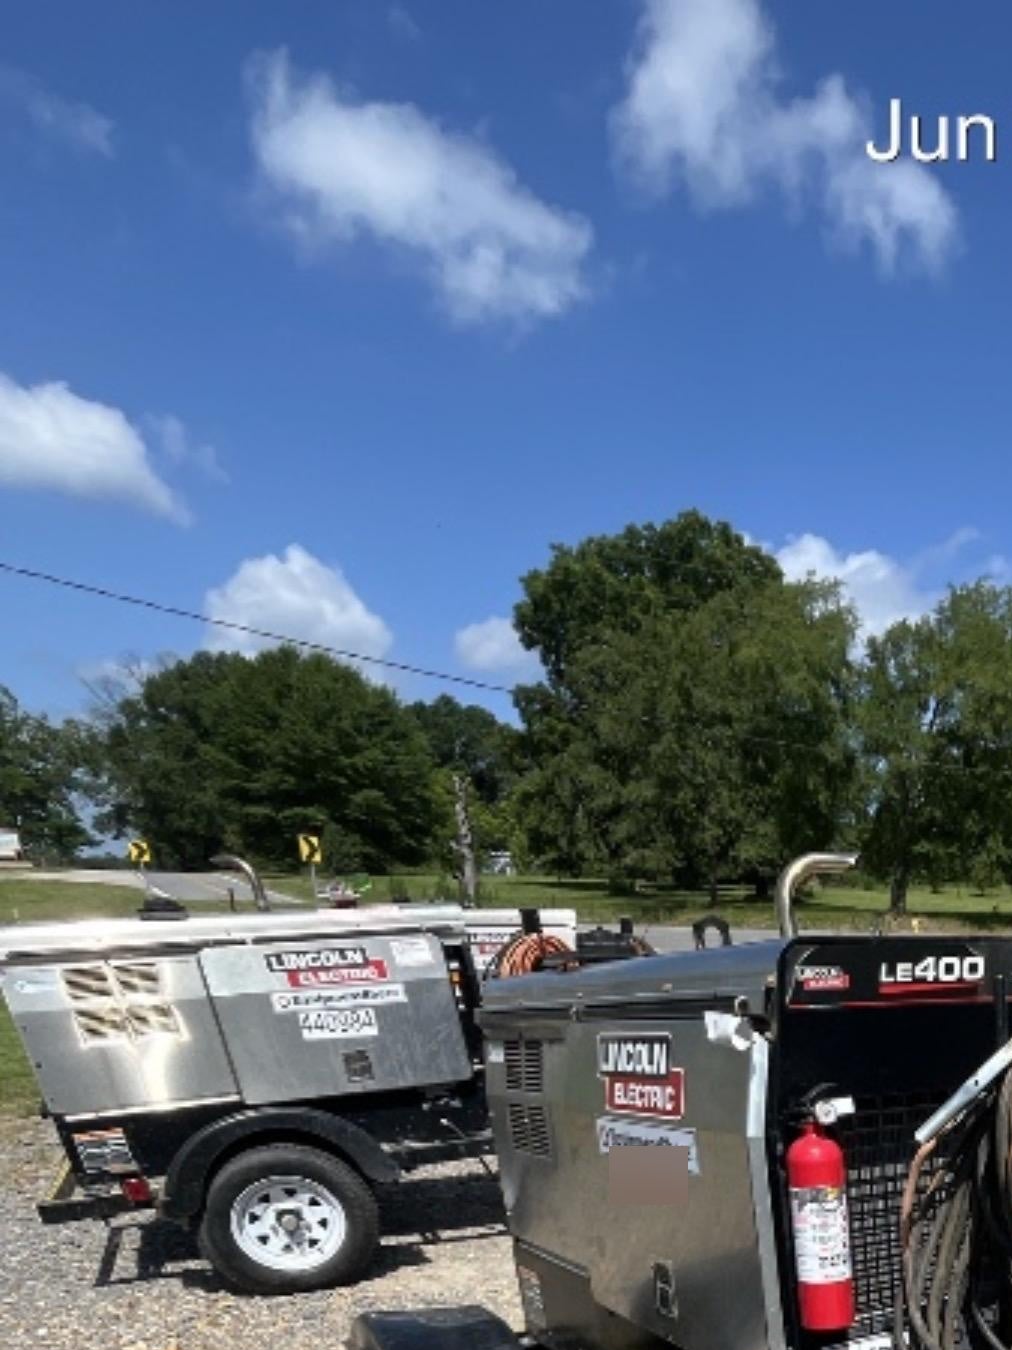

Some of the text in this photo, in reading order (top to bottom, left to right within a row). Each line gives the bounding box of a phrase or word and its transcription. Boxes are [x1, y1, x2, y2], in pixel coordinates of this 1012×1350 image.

[270, 950, 365, 971] LINCOLN
[878, 956, 985, 982] LE400
[601, 1042, 667, 1076] LINCOLN
[614, 1082, 676, 1112] ELECTRIC
